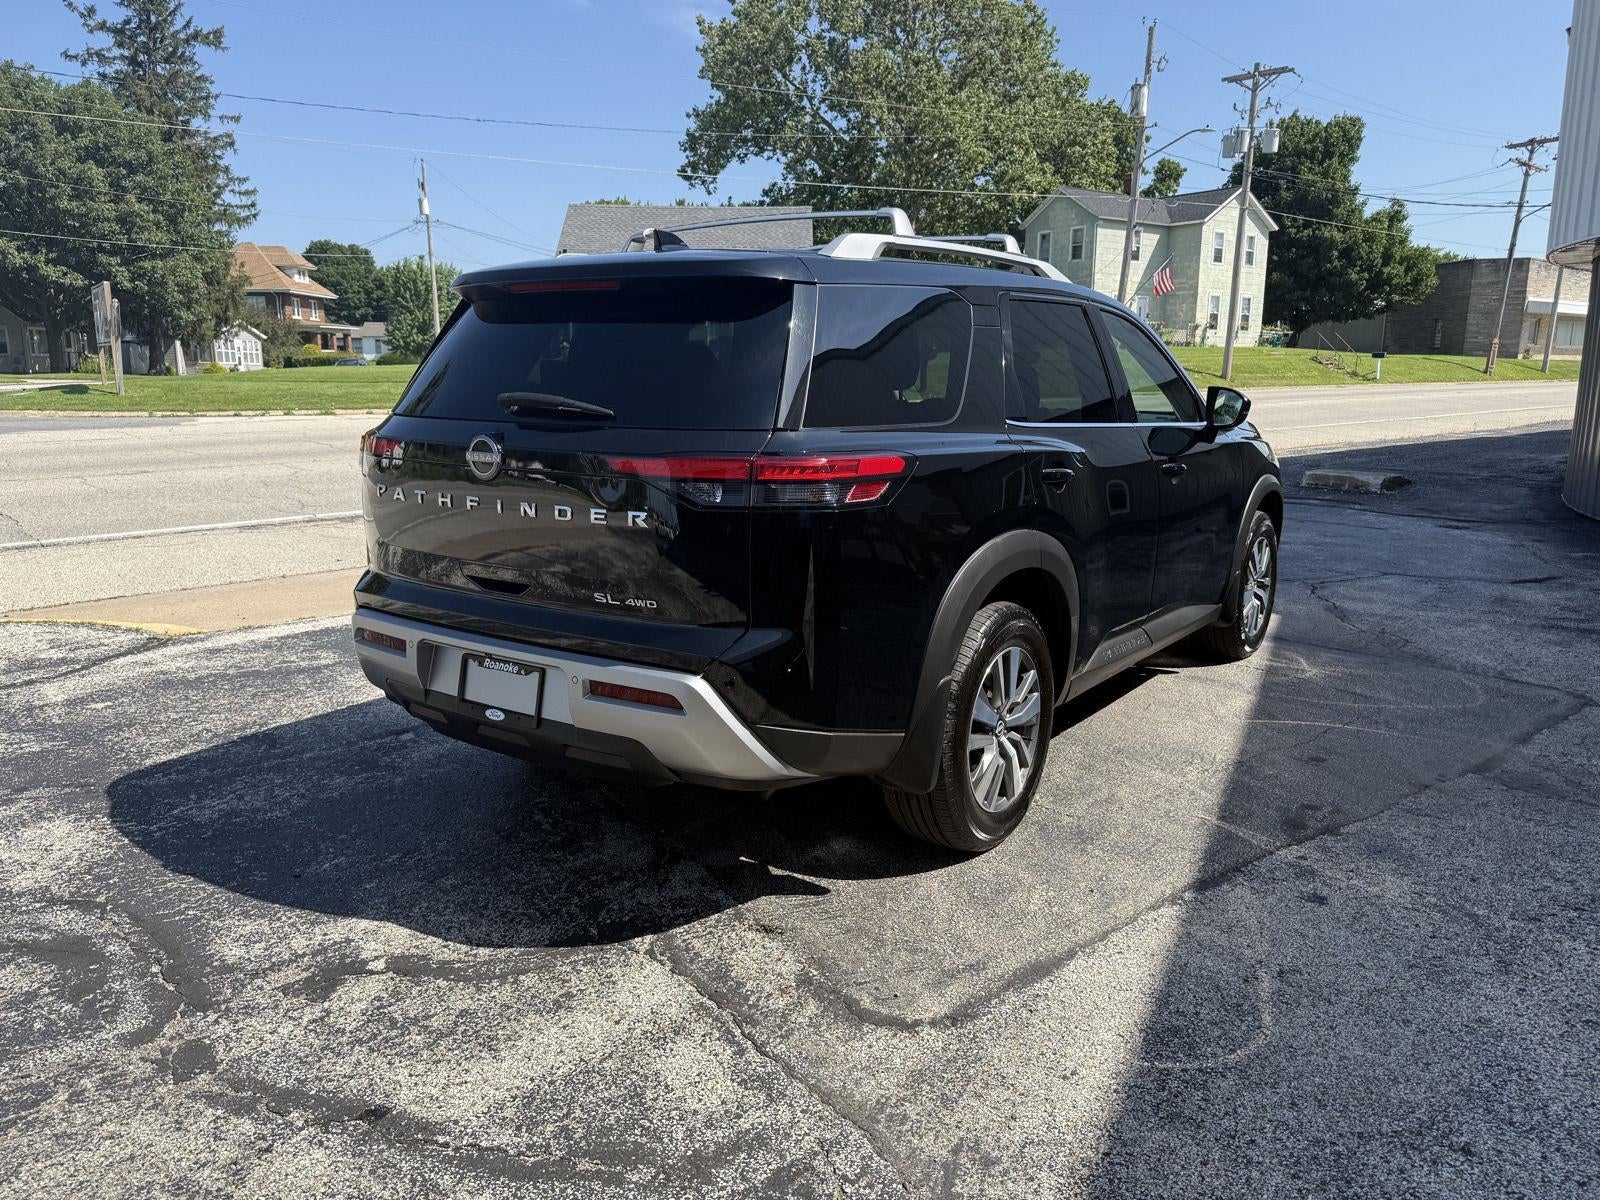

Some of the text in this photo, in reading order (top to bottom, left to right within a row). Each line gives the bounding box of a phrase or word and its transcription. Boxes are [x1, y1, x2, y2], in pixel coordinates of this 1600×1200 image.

[466, 451, 501, 462] NISSAN
[376, 484, 649, 528] PATHFINDER
[593, 592, 657, 608] SL 4WD
[483, 658, 519, 674] Roanoke
